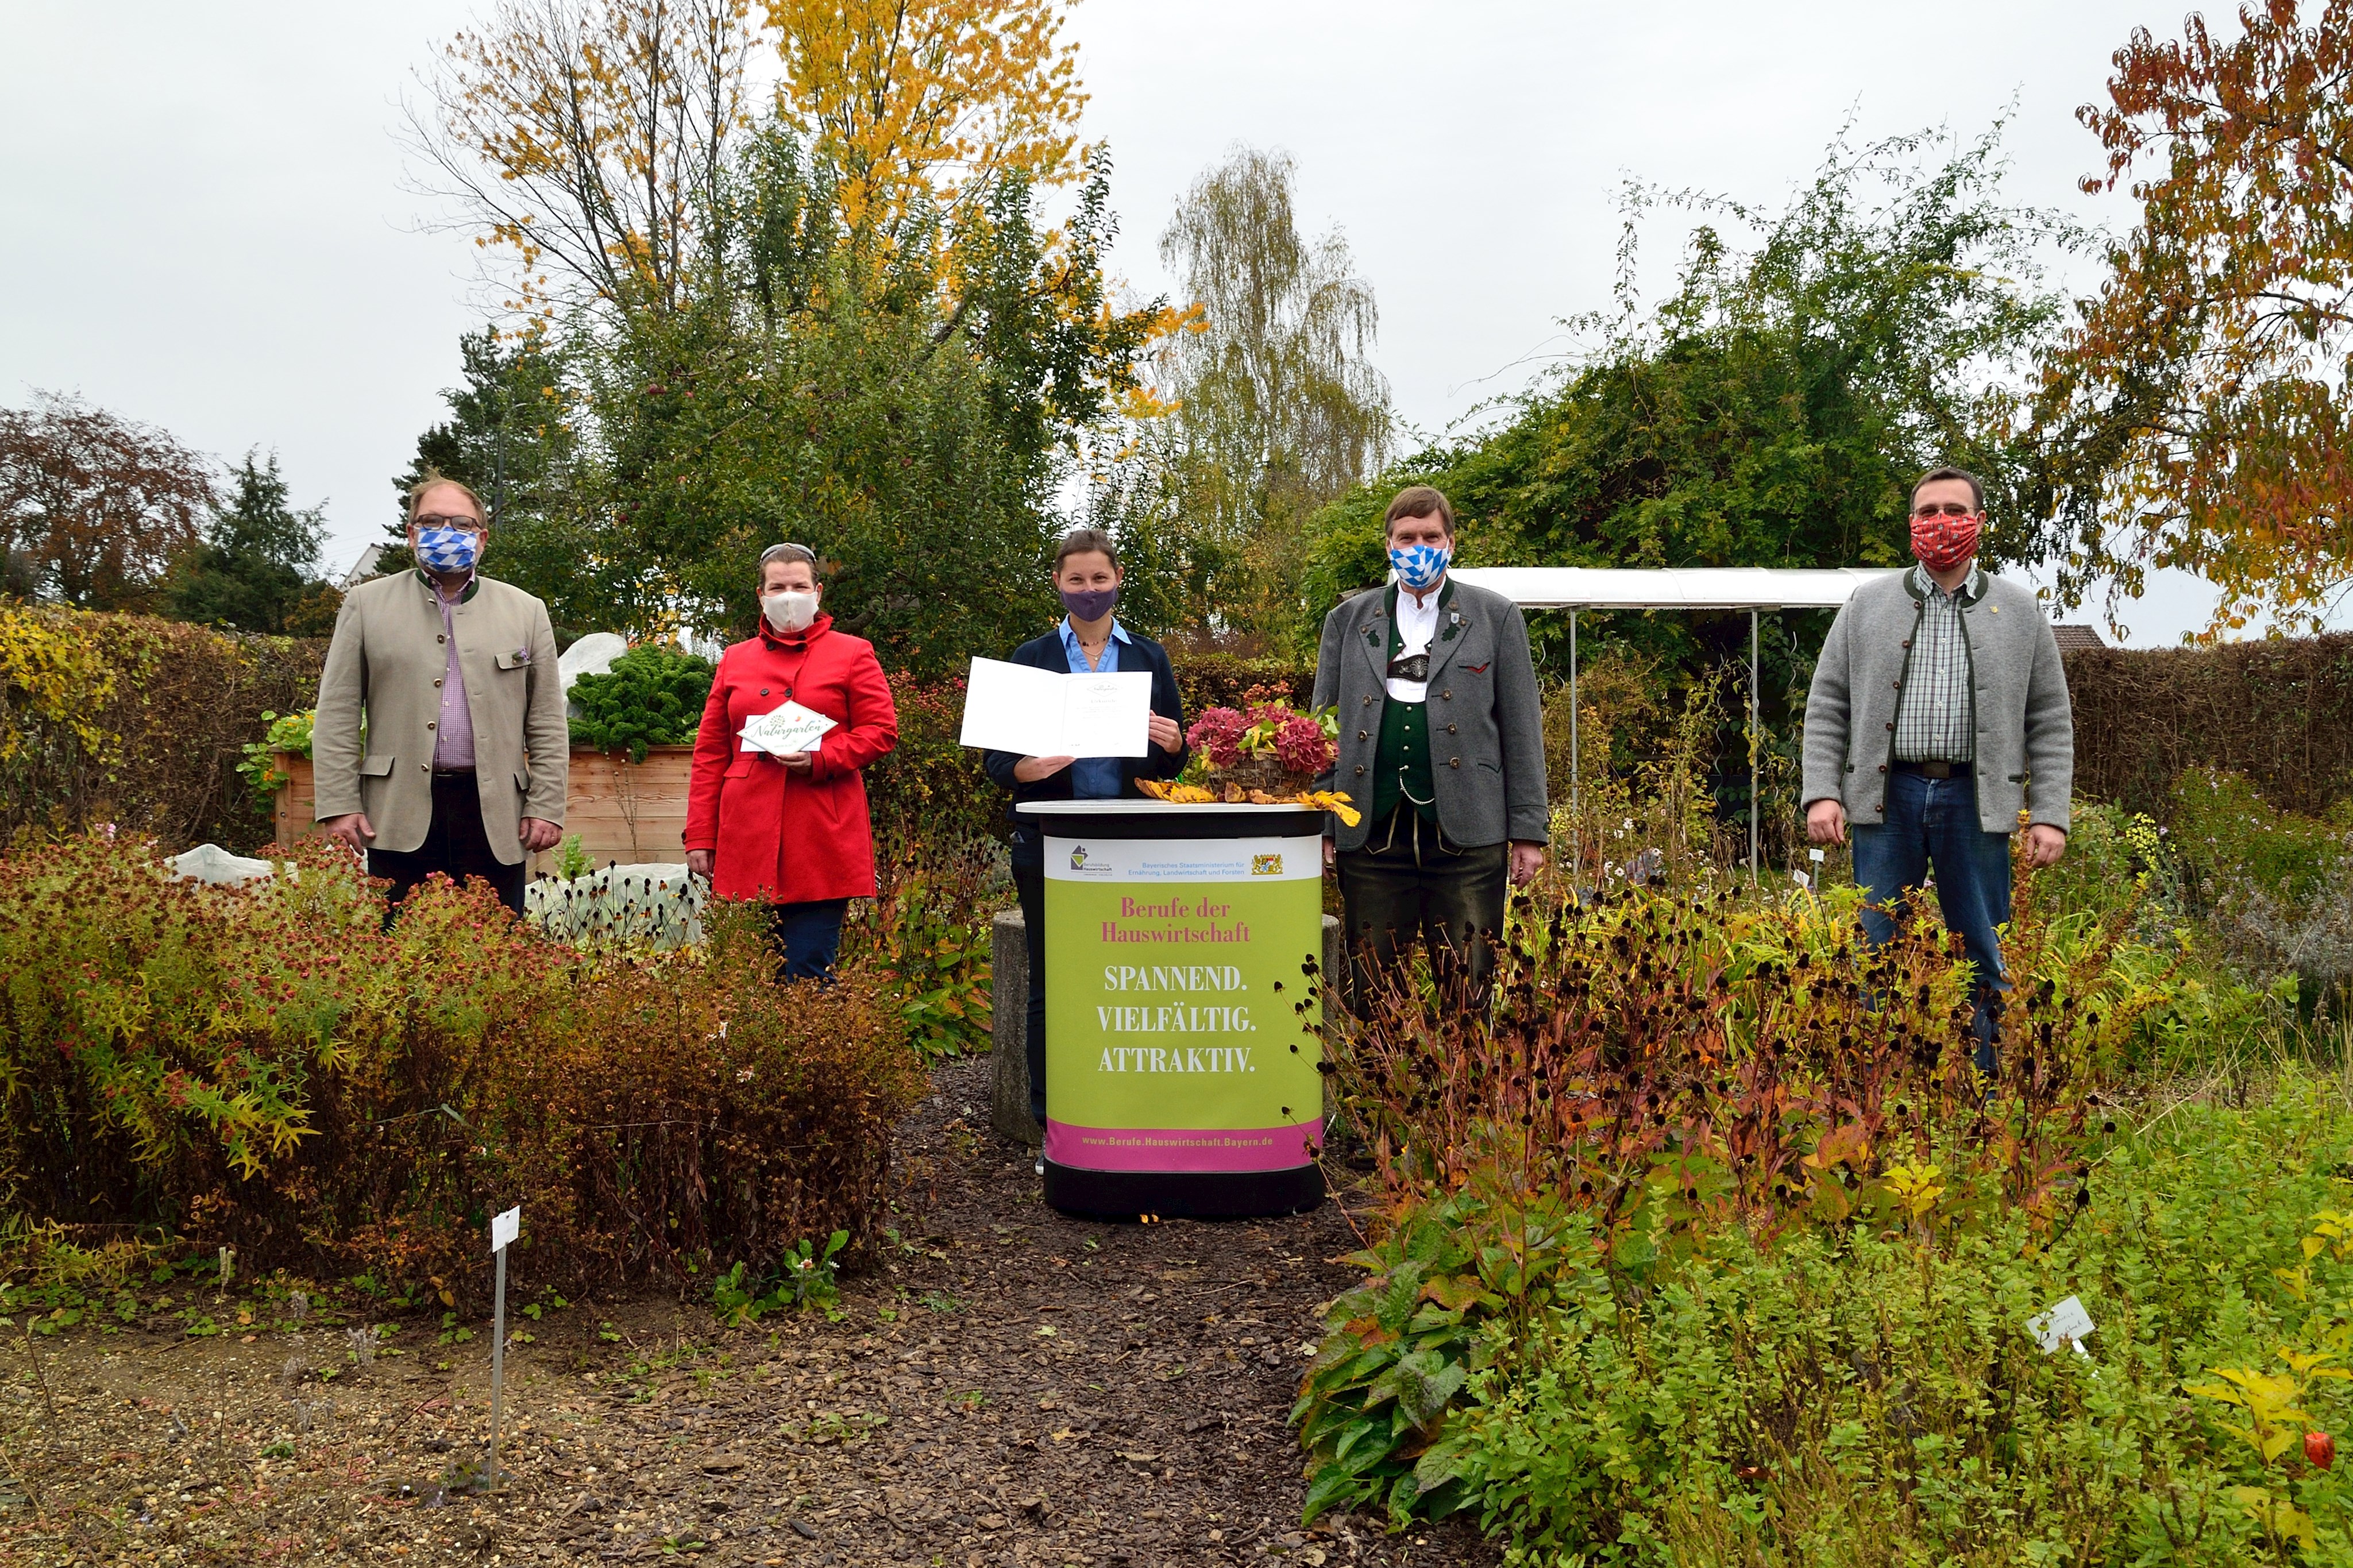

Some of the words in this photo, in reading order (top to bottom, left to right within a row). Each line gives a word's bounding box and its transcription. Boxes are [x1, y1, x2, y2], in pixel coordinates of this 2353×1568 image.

[751, 720, 823, 740] Naturgarten
[1121, 897, 1189, 917] Berufe
[1196, 897, 1230, 917] der
[1101, 921, 1251, 942] Hauswirtschaft
[1104, 965, 1247, 991] SPANNEND.
[1097, 1001, 1256, 1032] VIELFÄLTIG.
[1098, 1047, 1255, 1072] ATTRAKTIV.
[1082, 1137, 1273, 1148] www.Berufe.Hauswirtschaft.Bayern.de
